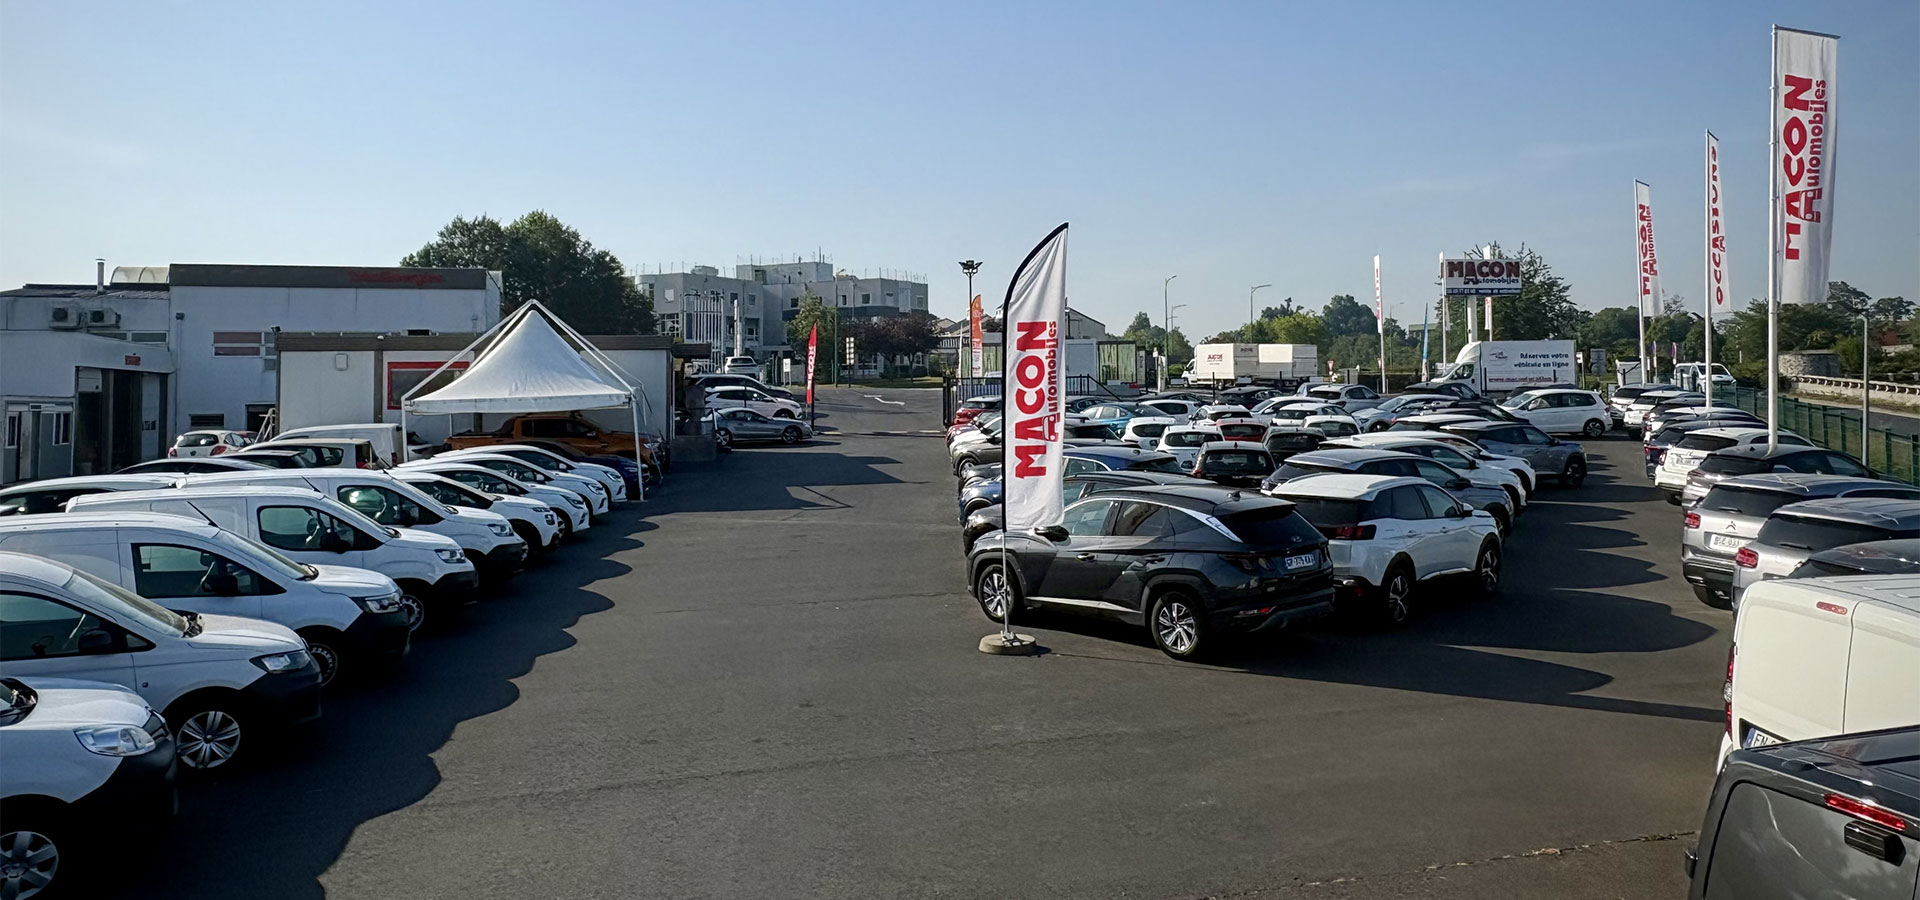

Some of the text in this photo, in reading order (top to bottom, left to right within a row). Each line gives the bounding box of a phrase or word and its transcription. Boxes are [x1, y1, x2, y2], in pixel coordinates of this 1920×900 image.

[1711, 146, 1726, 305] OCCASIONS
[1783, 74, 1813, 261] MACON
[1447, 261, 1521, 278] MACON
[1639, 204, 1651, 295] MACON
[1015, 320, 1047, 479] MACON
[1551, 361, 1569, 369] ligne
